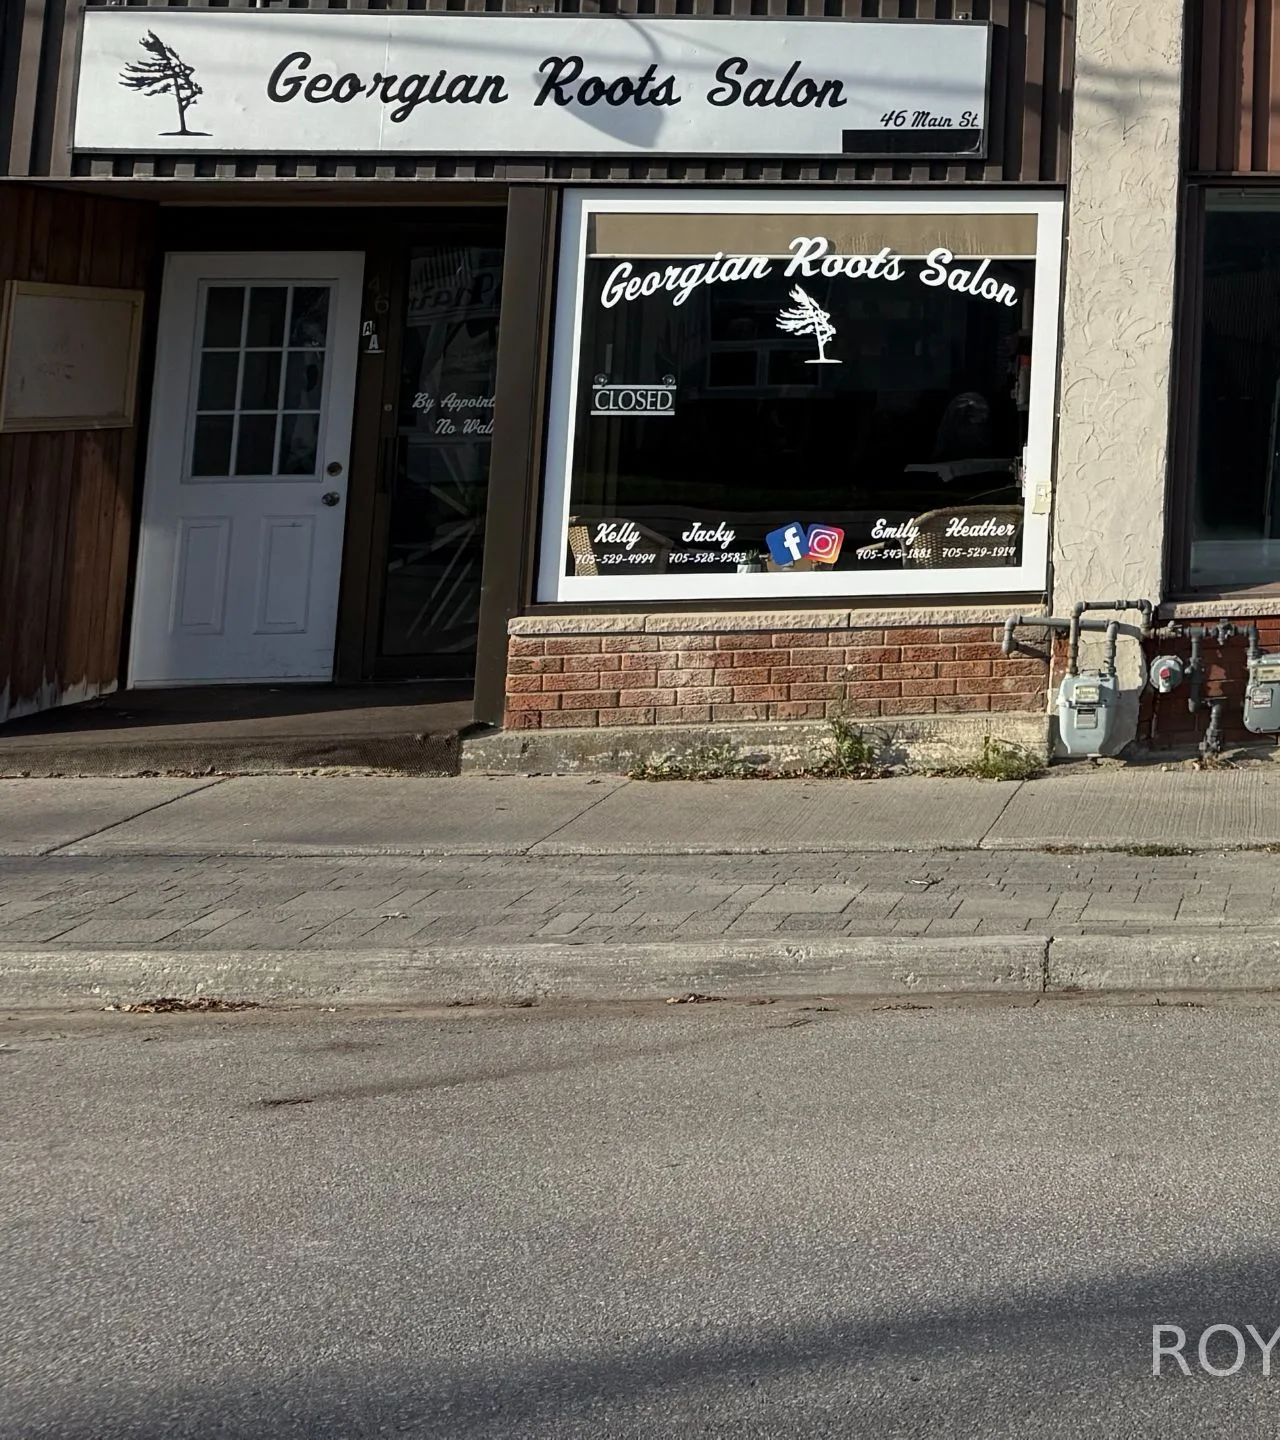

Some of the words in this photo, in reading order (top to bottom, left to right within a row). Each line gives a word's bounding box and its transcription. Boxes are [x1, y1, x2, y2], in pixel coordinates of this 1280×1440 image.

[267, 51, 508, 122] Georgian
[534, 56, 681, 107] Roots
[706, 57, 847, 108] Salon
[880, 110, 908, 127] 46
[911, 111, 953, 127] Main
[600, 252, 772, 308] Georgian
[783, 236, 905, 281] Roots
[919, 247, 1019, 307] Salon
[412, 392, 436, 414] By
[594, 389, 672, 411] CLOSED
[435, 418, 456, 435] No
[594, 522, 642, 550] Kelly
[682, 521, 736, 549] Jacky
[871, 517, 920, 545] Emily
[945, 517, 1015, 538] Heather
[942, 546, 1016, 559] 705-529-1914
